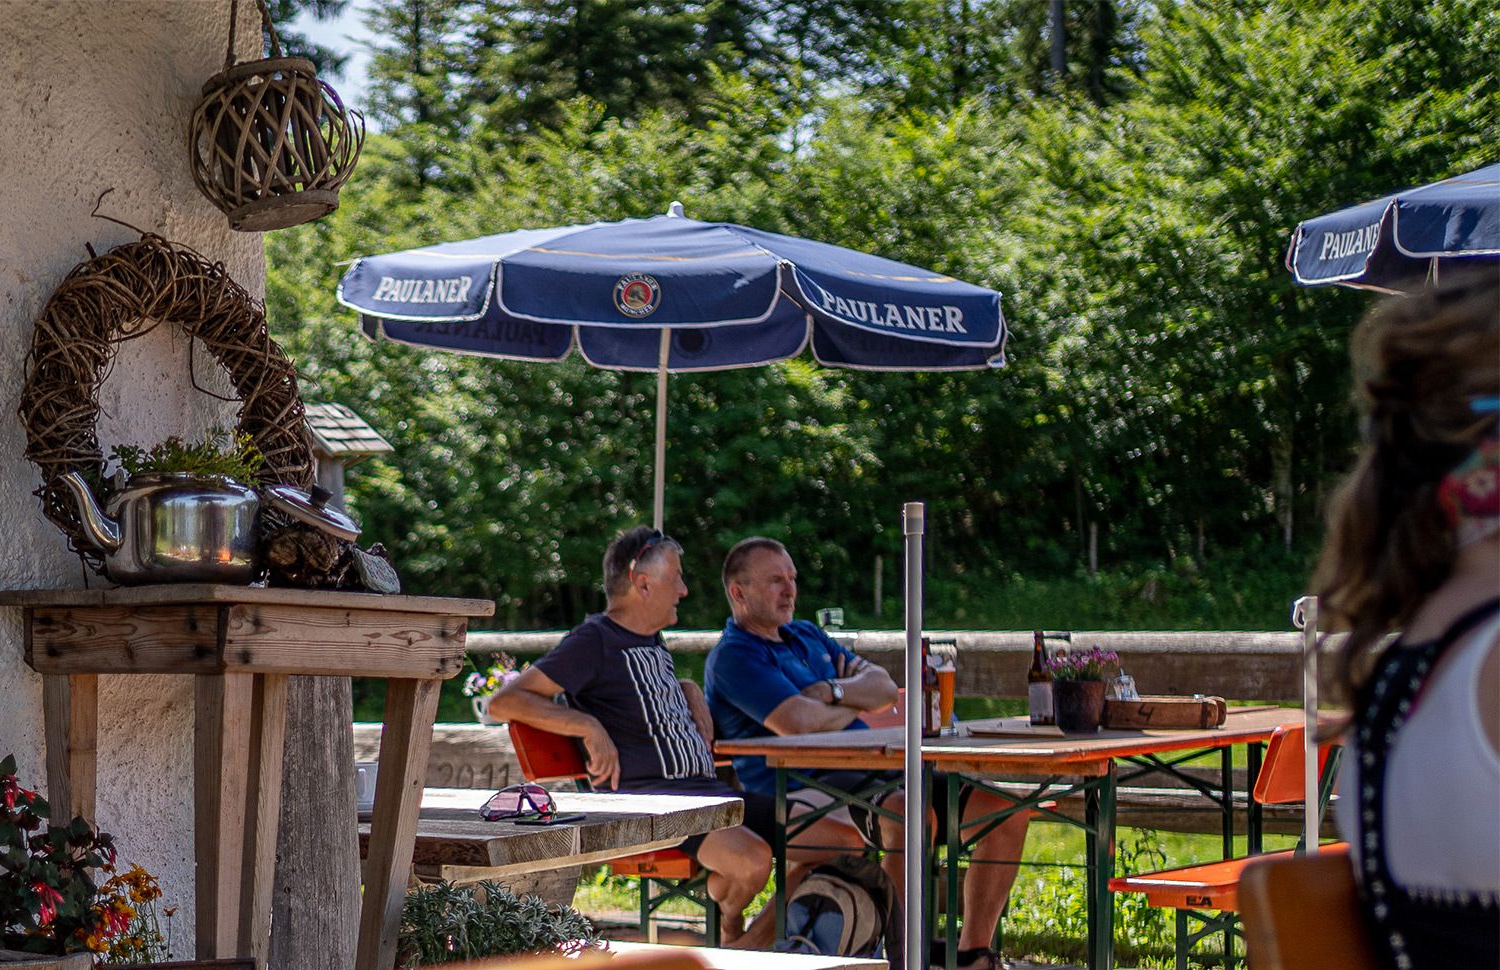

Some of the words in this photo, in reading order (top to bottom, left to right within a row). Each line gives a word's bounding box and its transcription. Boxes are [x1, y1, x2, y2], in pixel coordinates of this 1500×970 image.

[1320, 222, 1380, 260] PAULANE
[372, 275, 473, 304] PAULANER
[819, 289, 969, 335] PAULANER
